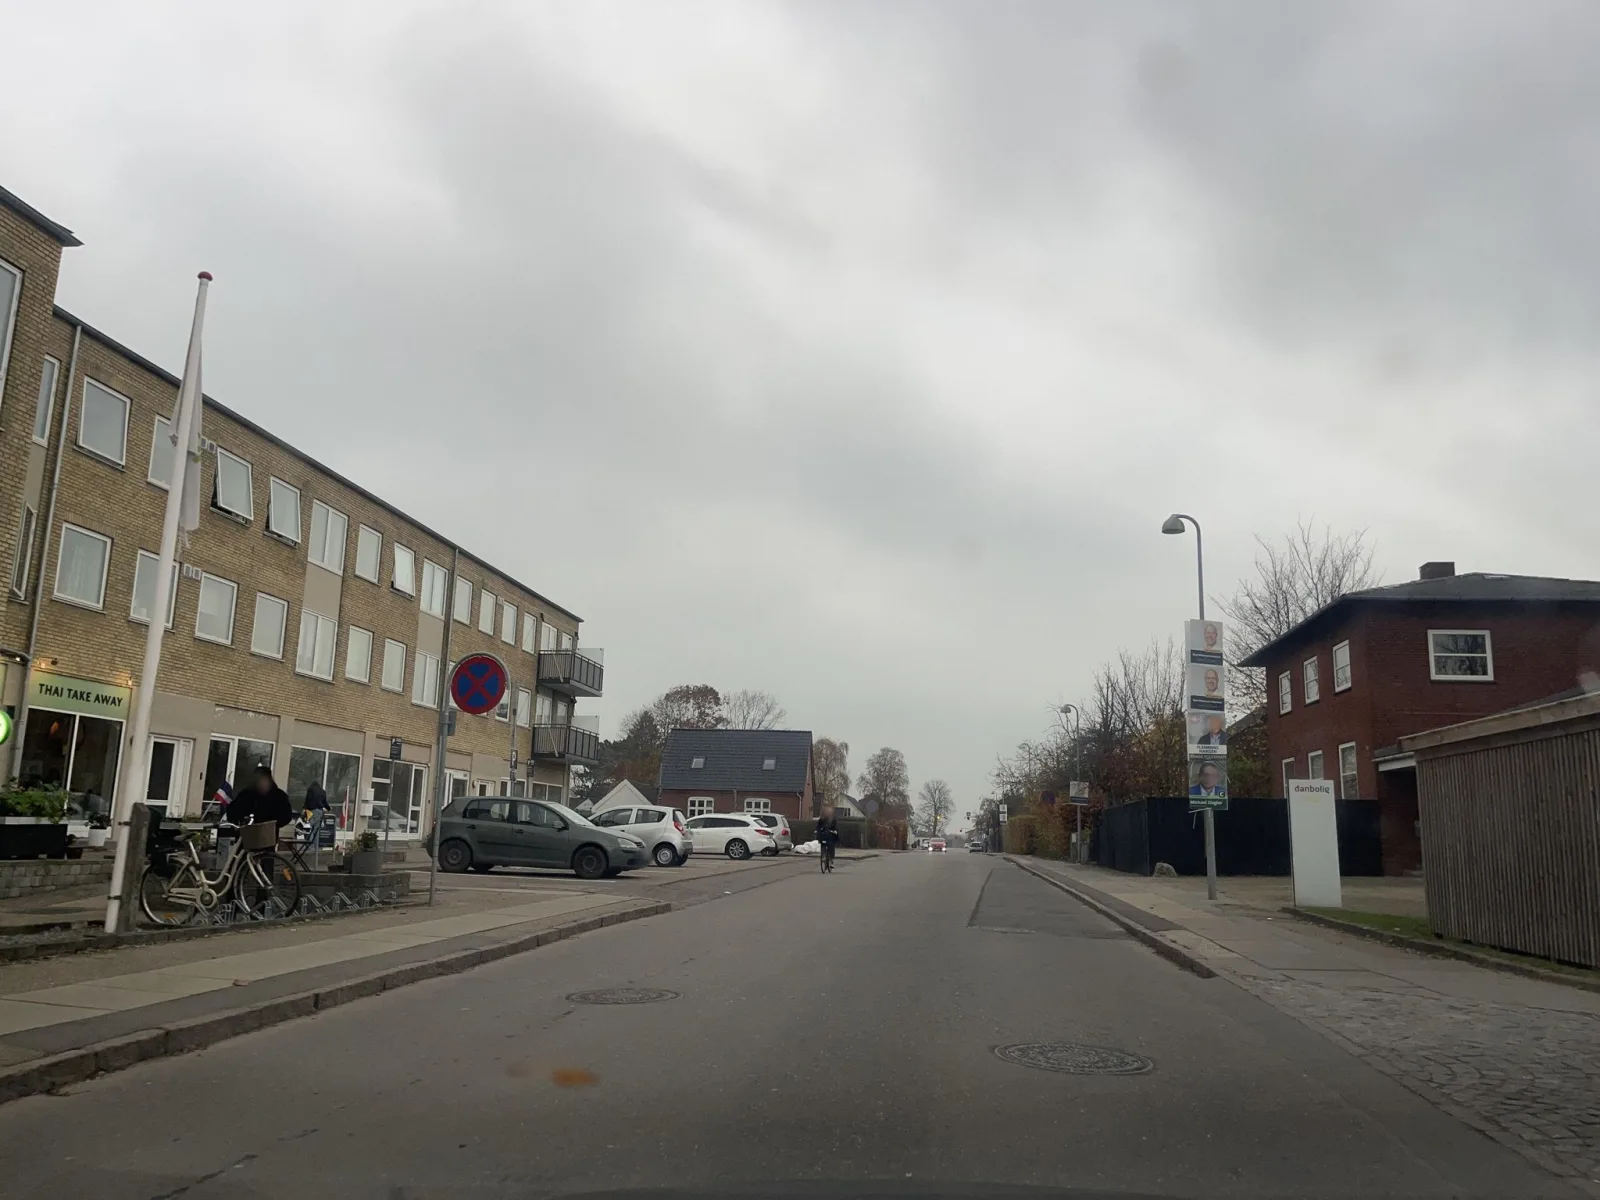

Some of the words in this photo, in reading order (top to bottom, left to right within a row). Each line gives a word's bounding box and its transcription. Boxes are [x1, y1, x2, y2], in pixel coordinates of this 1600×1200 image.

[39, 683, 64, 698] THAI
[67, 688, 92, 702] TAKE
[93, 693, 123, 707] AWAY
[1294, 785, 1330, 794] danbolig
